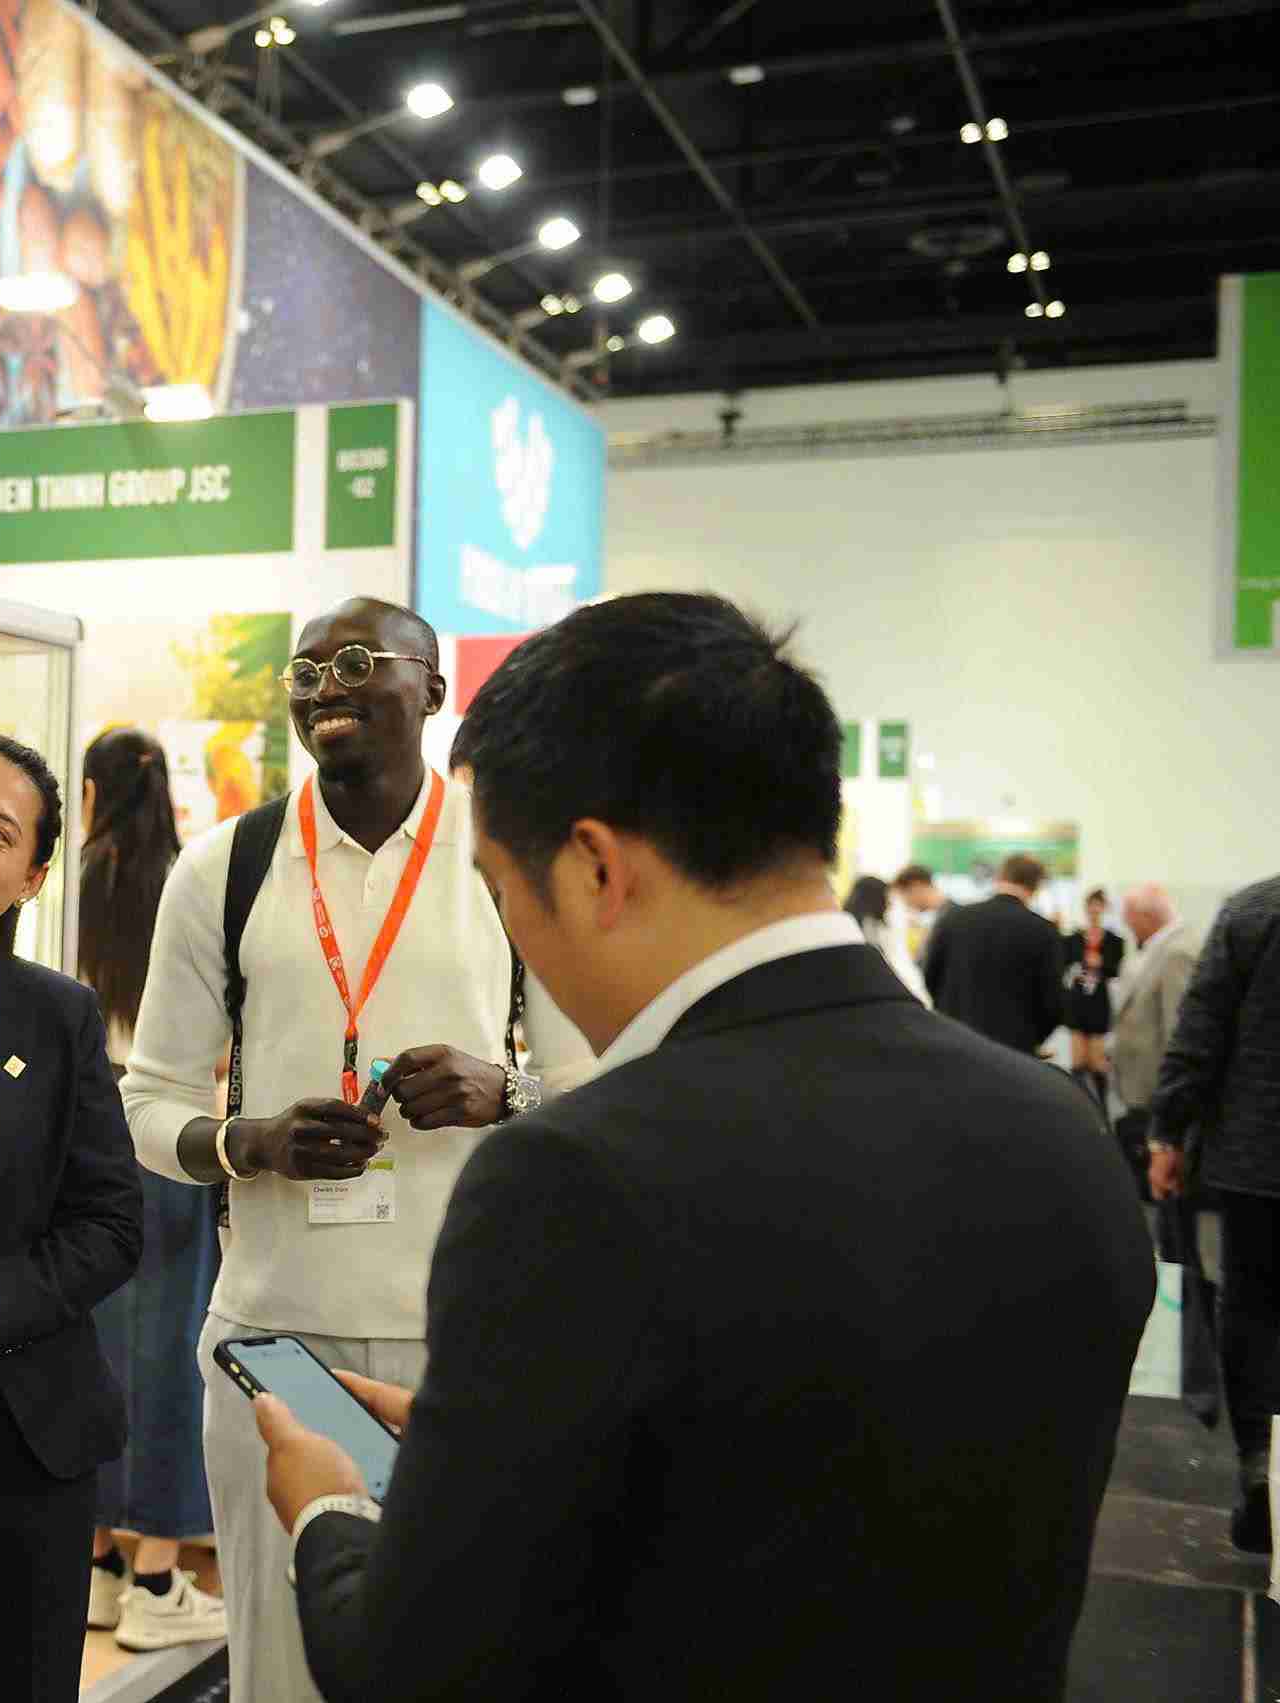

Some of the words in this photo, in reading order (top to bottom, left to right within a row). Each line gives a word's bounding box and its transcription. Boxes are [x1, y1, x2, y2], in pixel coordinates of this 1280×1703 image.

[36, 473, 106, 512] THINH
[108, 467, 186, 508] GROUP
[188, 463, 231, 503] JSC
